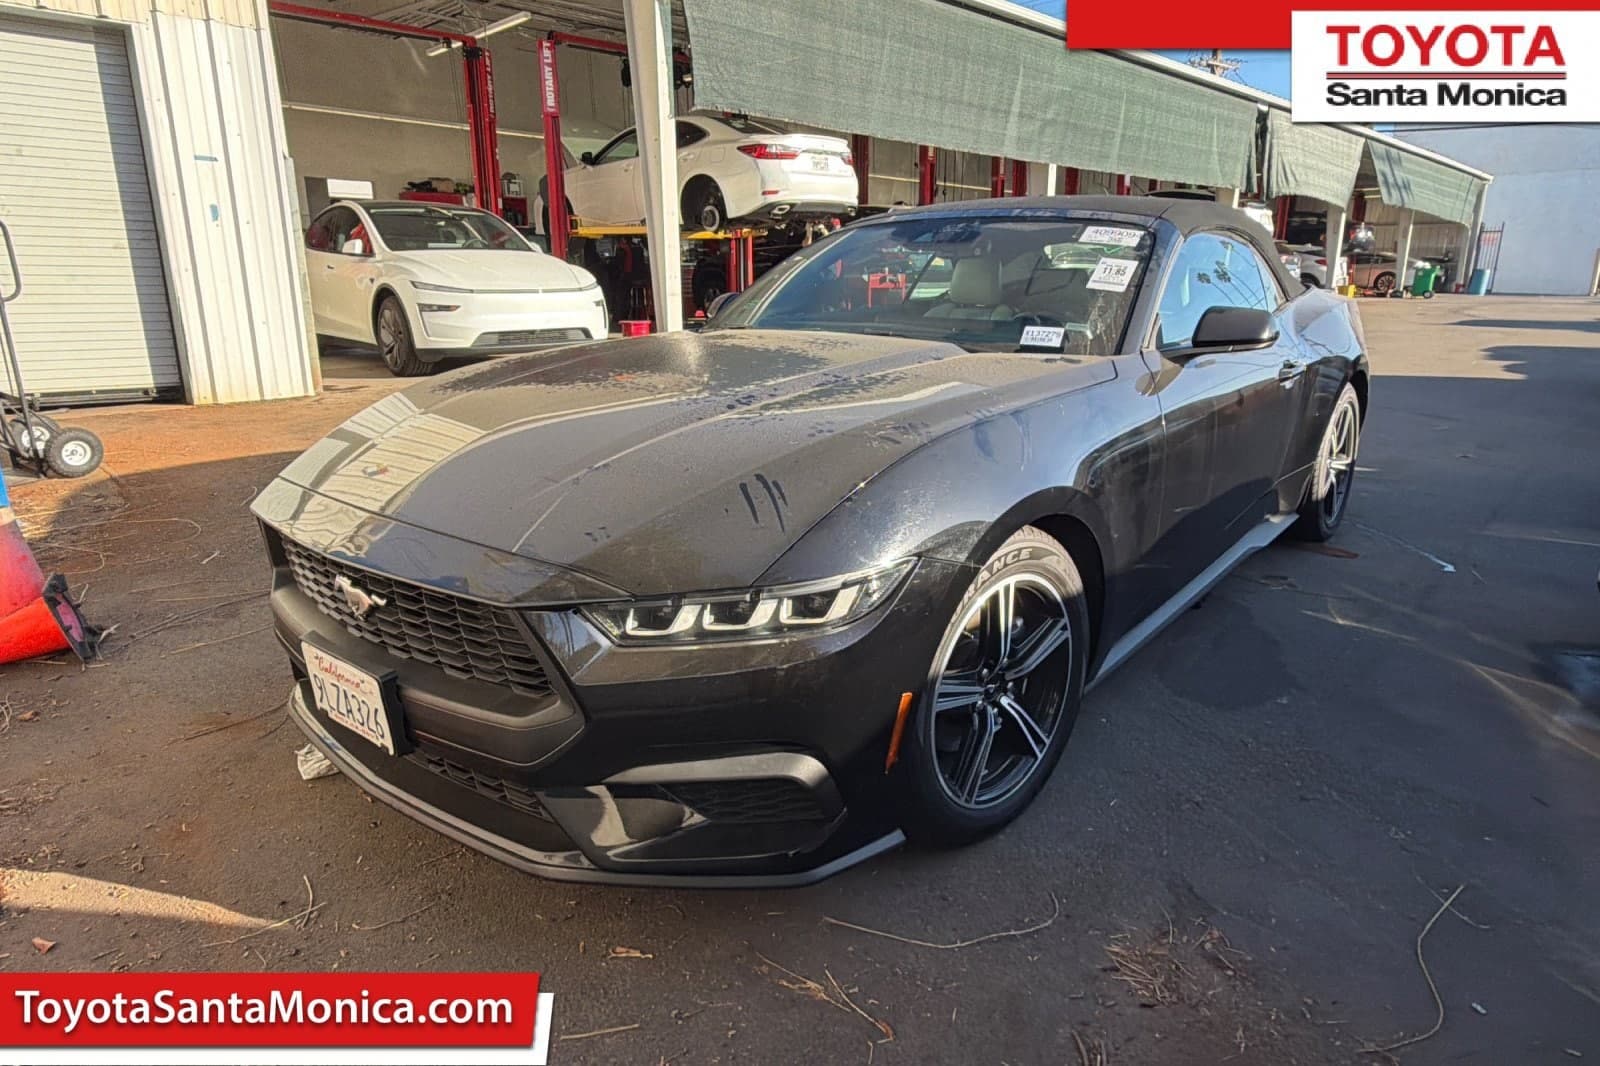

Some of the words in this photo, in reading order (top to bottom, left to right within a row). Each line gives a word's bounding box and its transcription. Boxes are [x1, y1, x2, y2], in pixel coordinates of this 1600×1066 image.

[542, 41, 552, 63] LIFT
[543, 65, 555, 107] ROTARY
[318, 656, 361, 689] California
[313, 672, 385, 740] 9LZA326
